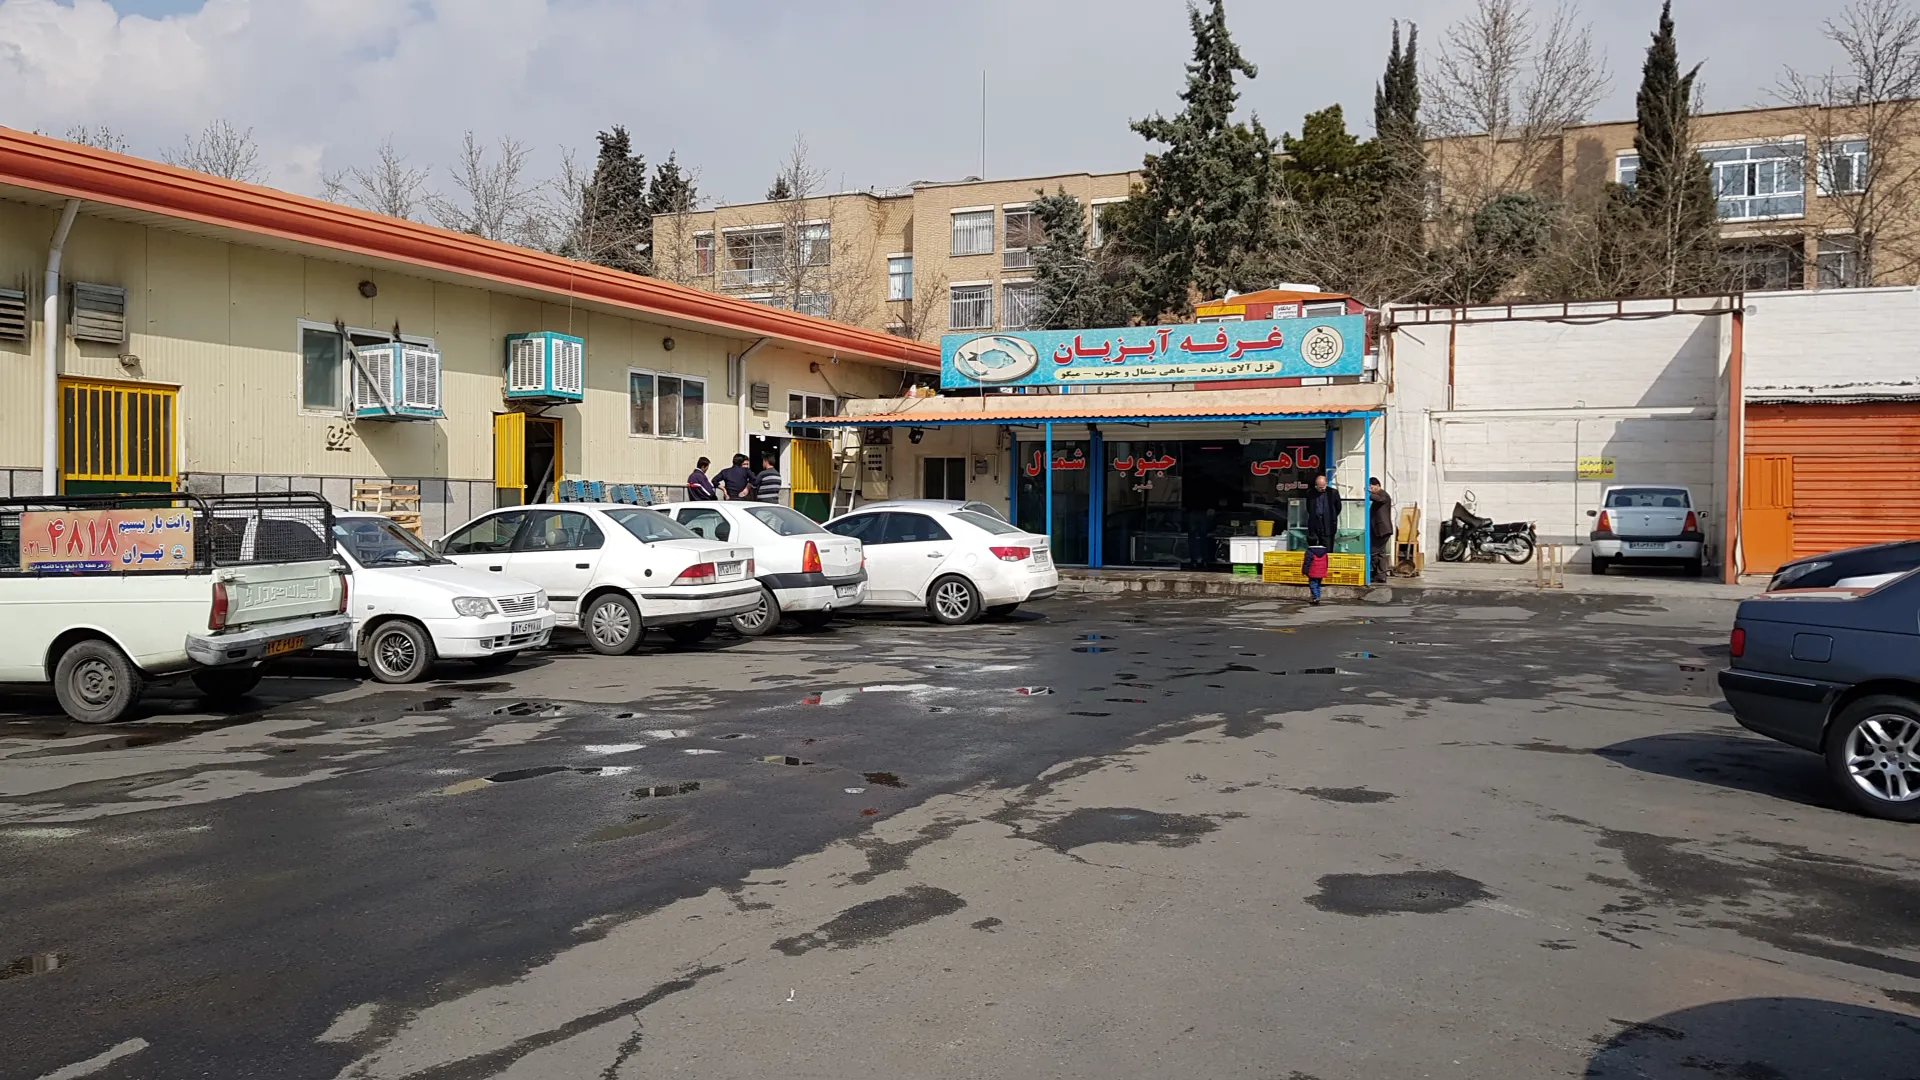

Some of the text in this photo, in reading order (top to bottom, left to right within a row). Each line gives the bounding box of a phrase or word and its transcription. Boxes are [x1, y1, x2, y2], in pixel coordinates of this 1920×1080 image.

[1053, 325, 1283, 364] غرفه آبزیان
[1094, 370, 1121, 378] جنوب
[1132, 368, 1157, 377] شمال
[1159, 366, 1186, 376] ماهی
[1200, 366, 1224, 375] زنده
[1226, 363, 1252, 374] آلای
[1254, 362, 1275, 372] قزل
[1113, 450, 1177, 478] جنوب
[1251, 446, 1320, 476] ماهی
[148, 514, 163, 534] بار
[165, 513, 191, 533] وانت
[122, 543, 164, 564] تهران
